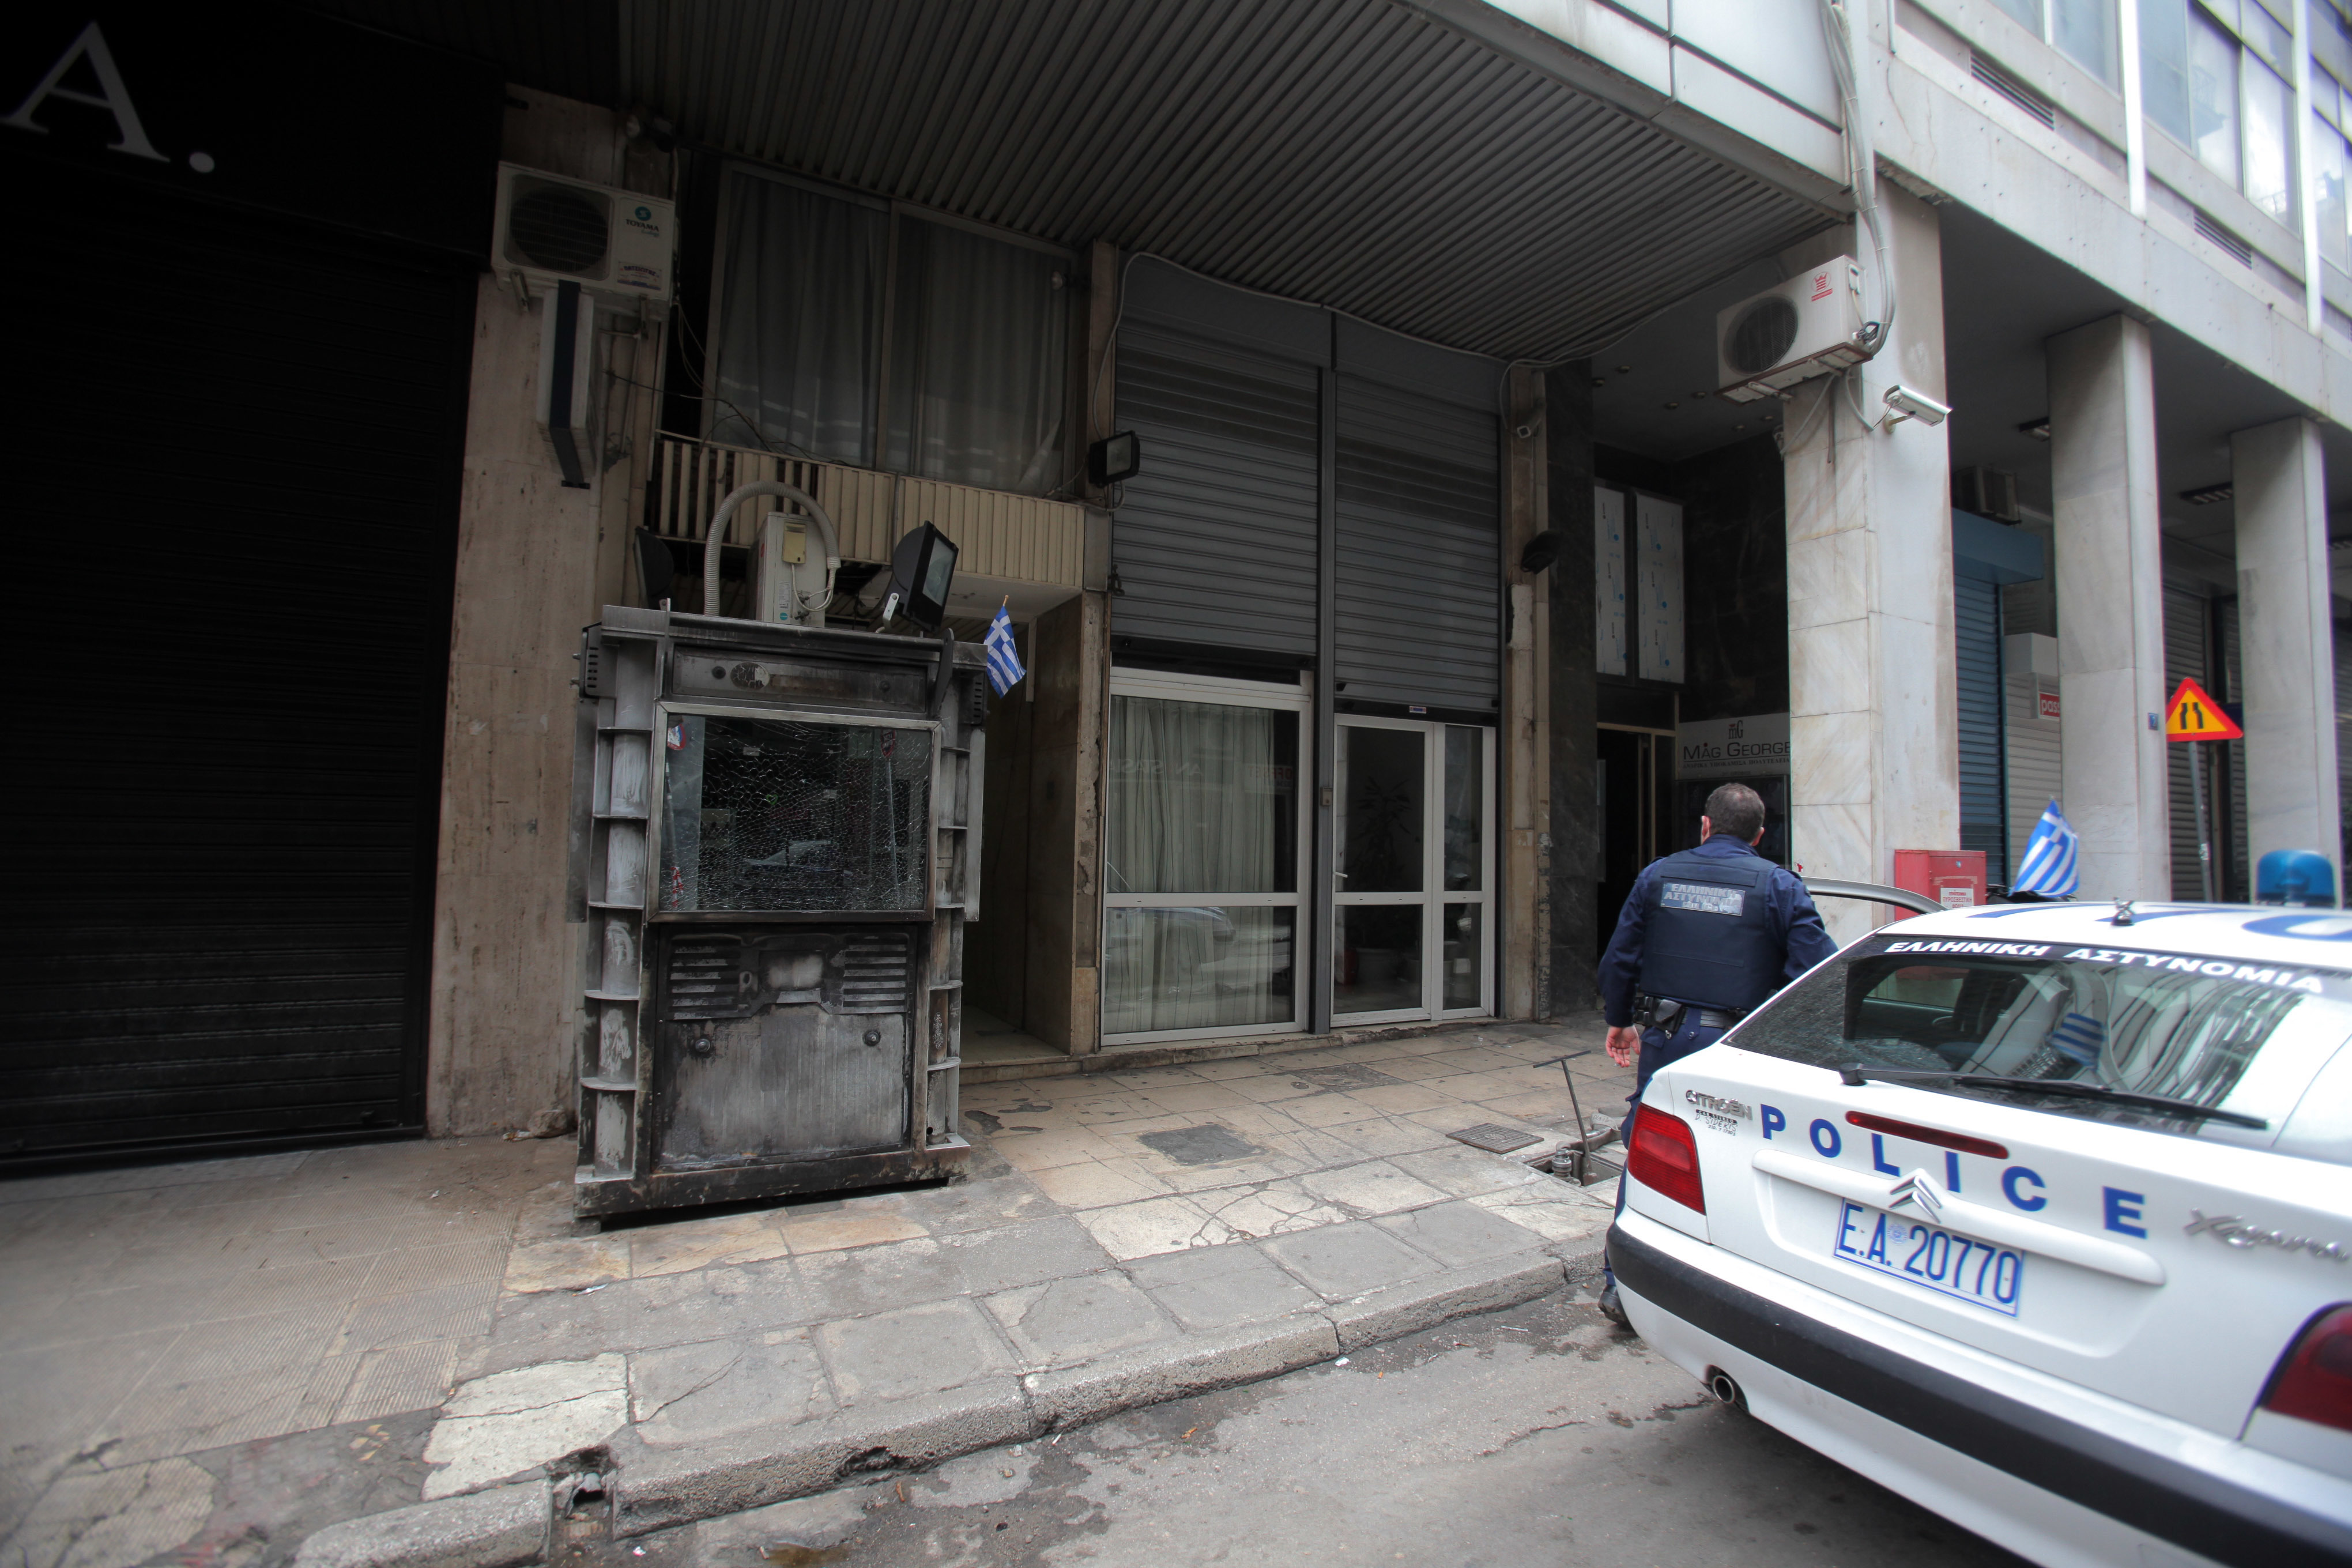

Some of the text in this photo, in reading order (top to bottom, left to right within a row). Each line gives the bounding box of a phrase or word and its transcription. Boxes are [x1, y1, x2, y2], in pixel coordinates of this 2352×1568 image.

[625, 218, 659, 232] TOYAMA
[1664, 891, 1742, 907] ΑΣΤΥΝΟΜΙΑ
[1671, 883, 1737, 899] ΕΛΛΗΝΙΚΗ
[1884, 940, 2323, 994] ΕΛΛΗΝΙΚΗ ΑΣΤΥΝΟΜΙΑ
[1705, 1116, 1738, 1132] SIDERIS
[1760, 1102, 2147, 1239] POLICE
[1904, 1224, 2021, 1304] 20770
